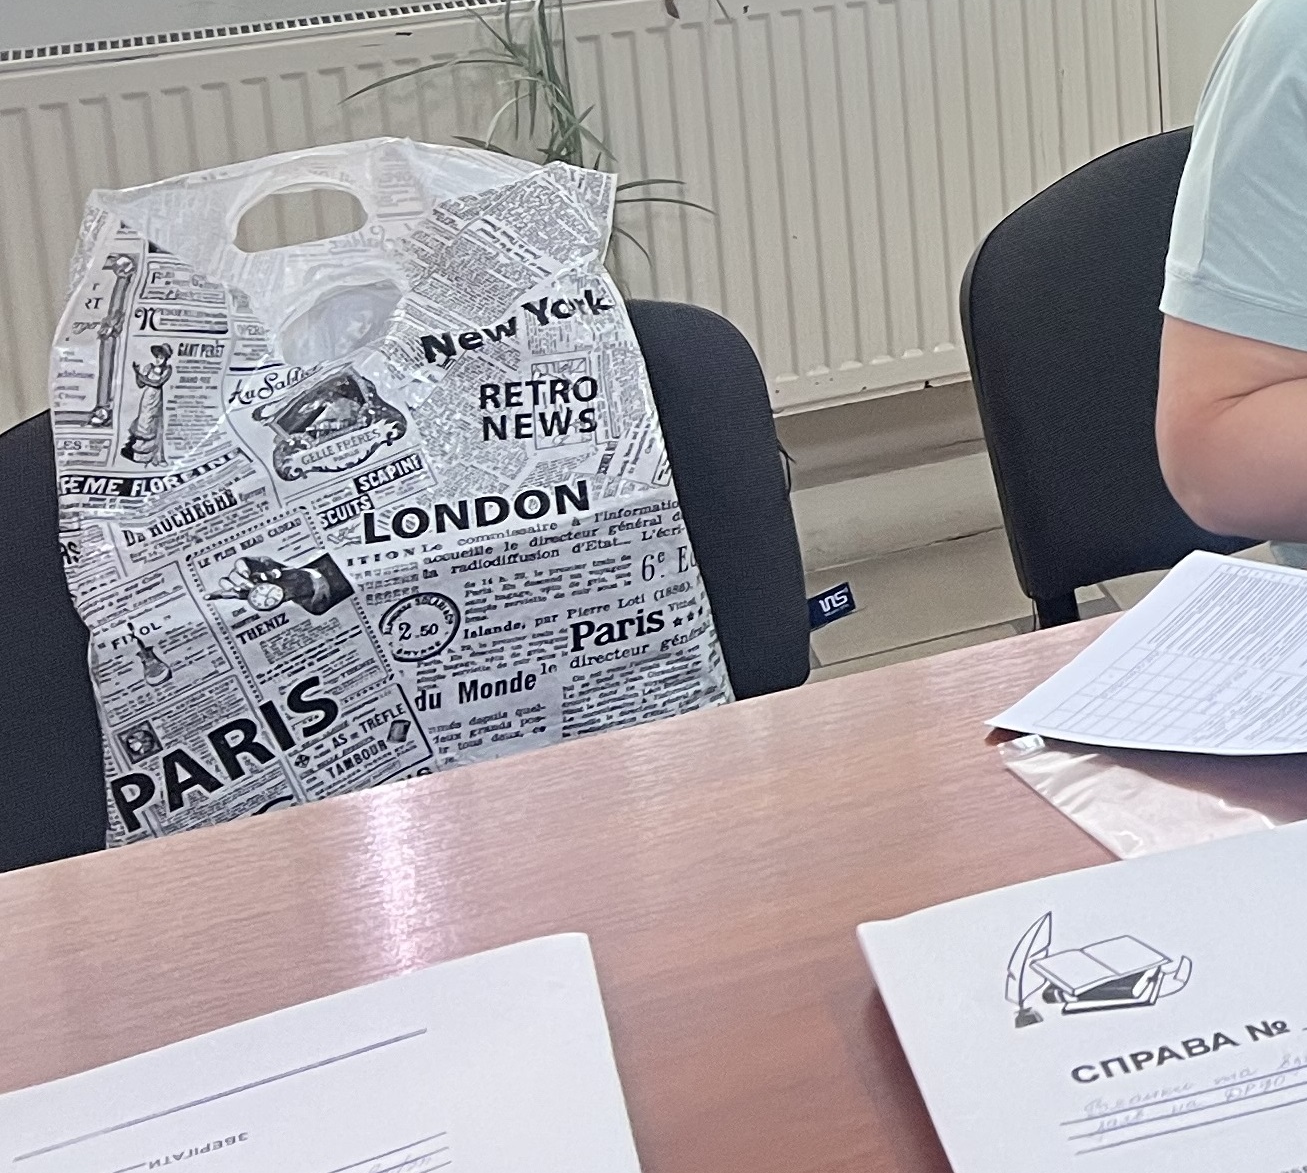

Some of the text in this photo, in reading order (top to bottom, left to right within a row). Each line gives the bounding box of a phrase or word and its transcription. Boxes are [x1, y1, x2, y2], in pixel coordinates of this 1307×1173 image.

[420, 289, 615, 364] New York
[478, 375, 599, 410] RETRO
[481, 407, 599, 442] NEWS
[364, 480, 590, 544] LONDON
[423, 514, 662, 566] accueille le directeur général
[457, 521, 557, 546] commissaire
[450, 547, 560, 575] radiodiffusion
[535, 613, 559, 628] par
[567, 603, 611, 620] Pierre
[617, 594, 645, 609] Loti
[569, 608, 666, 653] Paris
[541, 642, 650, 675] le directeur
[415, 670, 537, 713] du Monde
[111, 676, 340, 833] PARIS
[325, 739, 388, 779] TAMBOUR
[1070, 1031, 1240, 1084] СПРАВА
[1245, 1020, 1291, 1042] №
[148, 1131, 249, 1170] ЗБЕРІГАТИ
